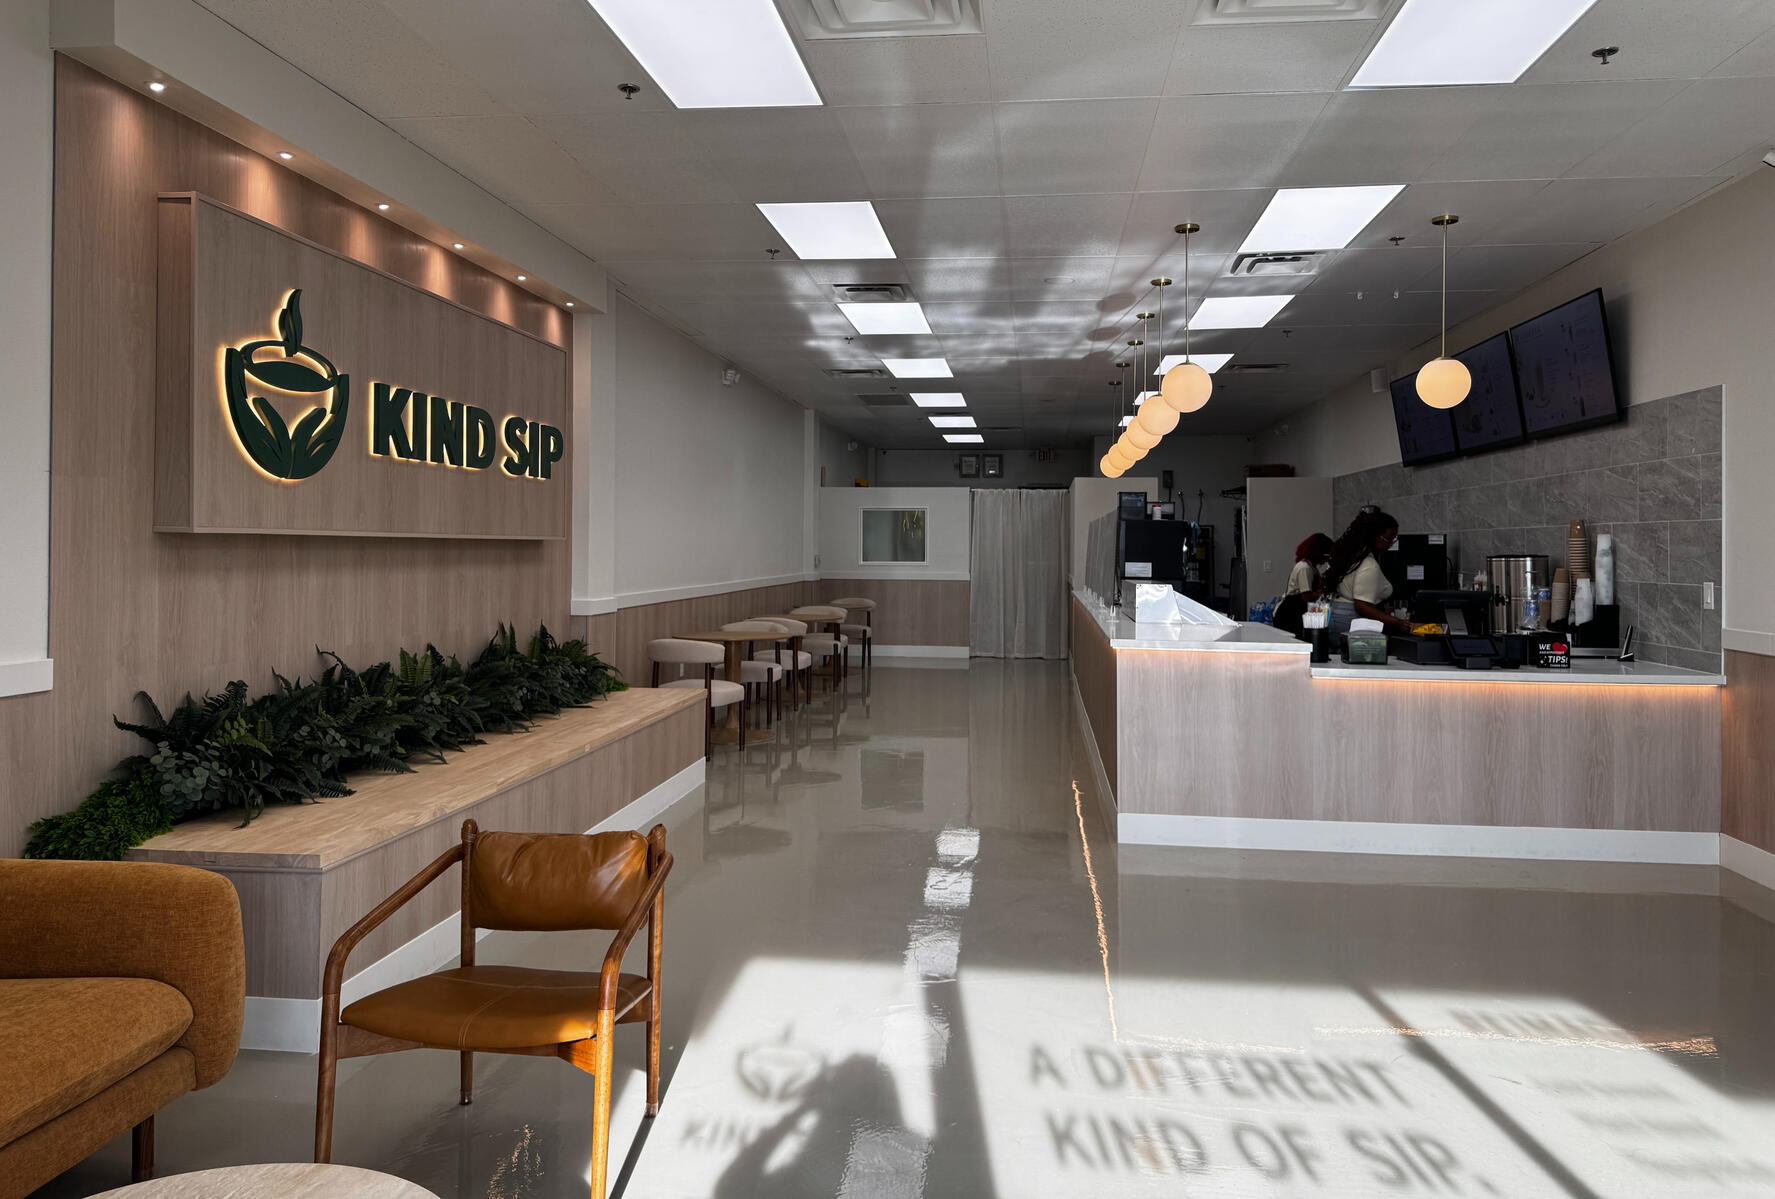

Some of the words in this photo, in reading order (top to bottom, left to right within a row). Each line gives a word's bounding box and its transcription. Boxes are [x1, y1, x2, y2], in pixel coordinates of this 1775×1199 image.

[371, 382, 496, 469] KIND
[502, 416, 564, 479] SIP
[1548, 655, 1568, 663] TIPS!
[1029, 1044, 1066, 1090] A
[1085, 1046, 1412, 1109] DIFFERENT
[1045, 1109, 1212, 1174] KIND
[1232, 1120, 1322, 1186] OF
[1345, 1125, 1500, 1195] SIP.
